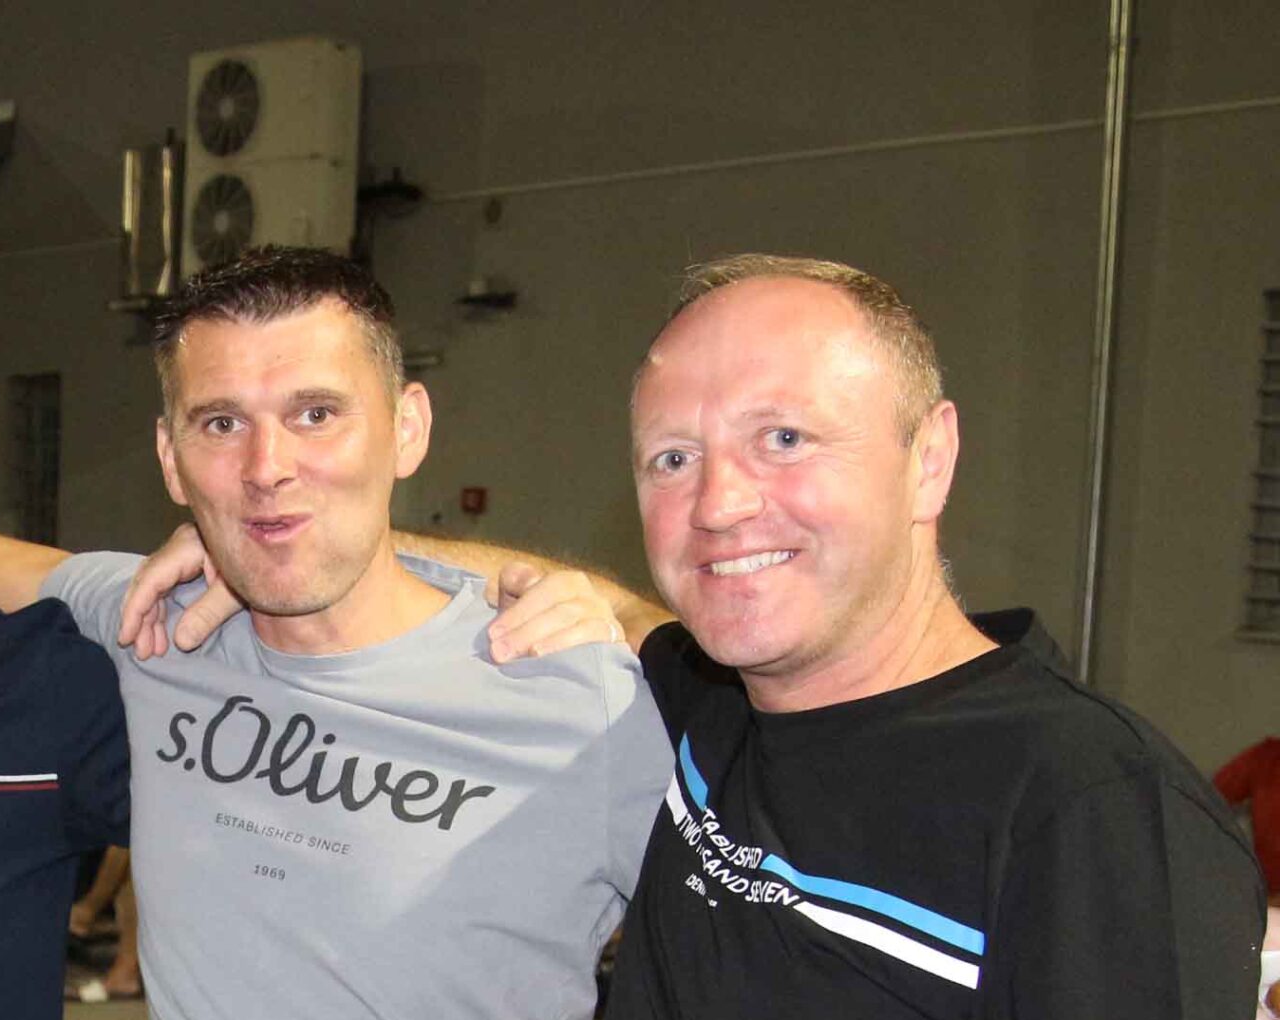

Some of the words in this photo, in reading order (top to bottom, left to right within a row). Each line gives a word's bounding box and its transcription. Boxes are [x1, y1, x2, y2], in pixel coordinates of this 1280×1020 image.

[156, 695, 496, 831] s.Oliver
[215, 812, 305, 845] ESTABLISHED
[307, 836, 352, 856] SINCE
[678, 812, 703, 846] TWO
[254, 864, 287, 881] 1969
